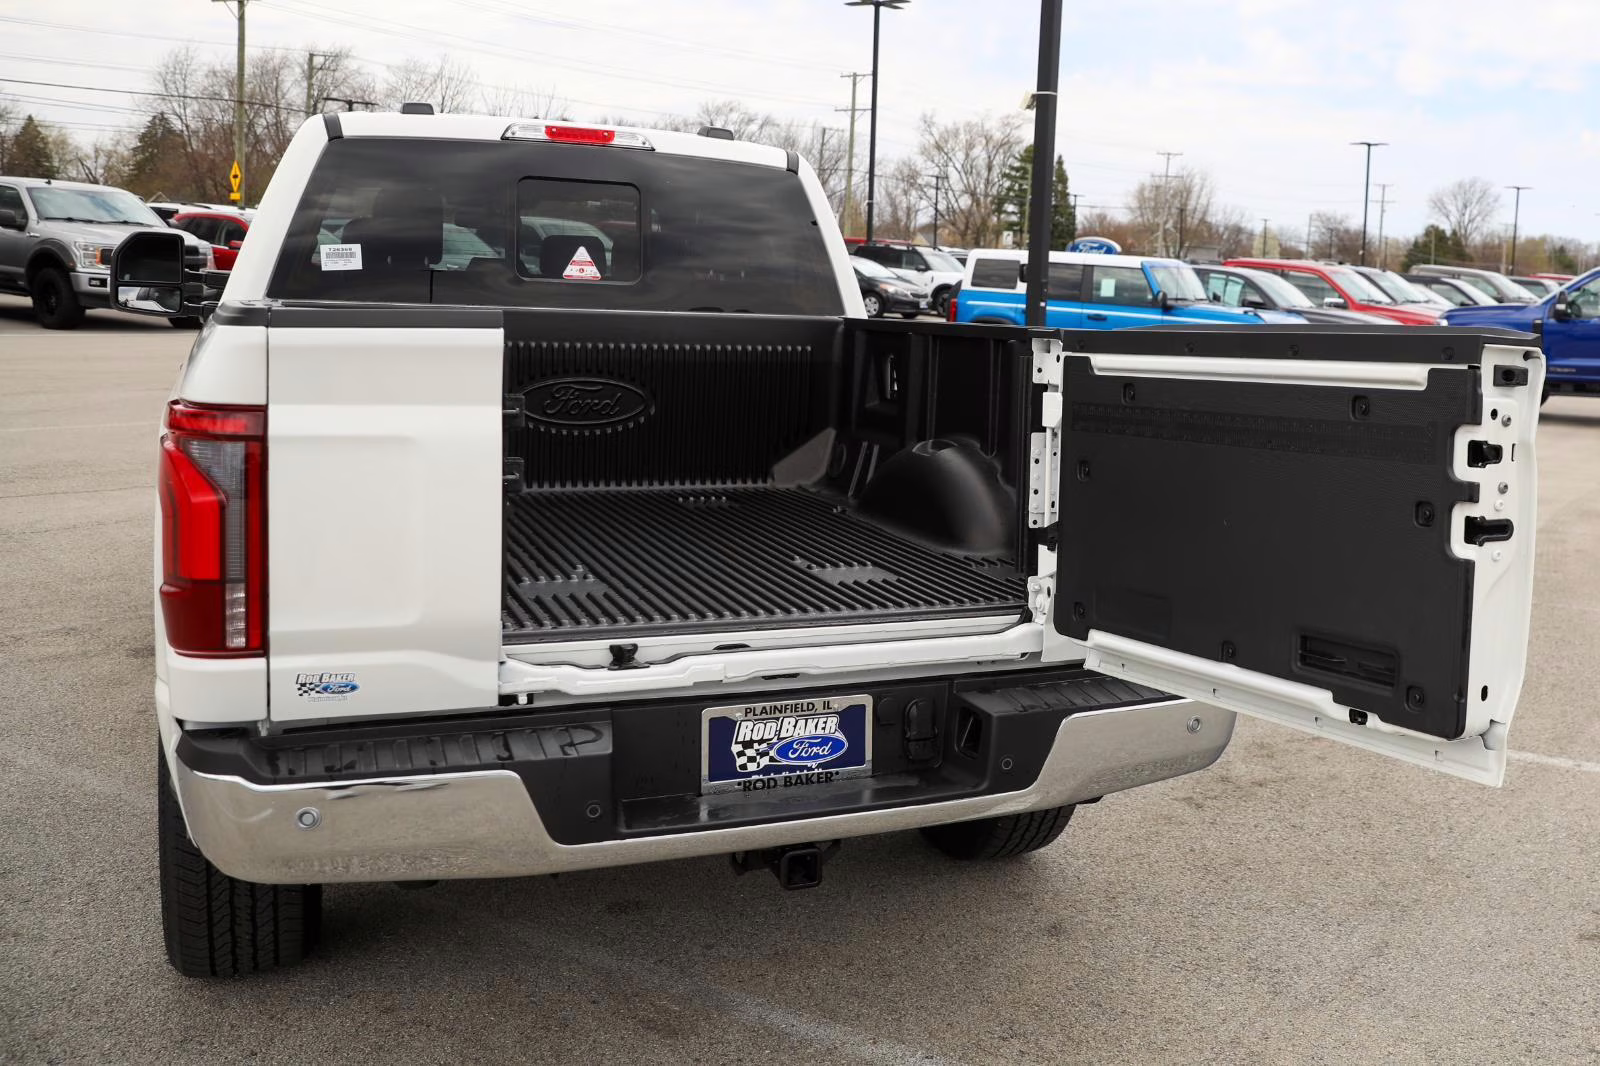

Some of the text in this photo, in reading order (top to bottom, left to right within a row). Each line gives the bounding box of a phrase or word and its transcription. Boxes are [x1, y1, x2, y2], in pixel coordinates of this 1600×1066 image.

[543, 383, 622, 415] Ford
[296, 673, 355, 684] ROD BAKER
[328, 684, 352, 693] Ford
[744, 701, 833, 718] PLAINFIELD, IL
[737, 716, 838, 742] ROD BAKER
[788, 737, 832, 758] Ford
